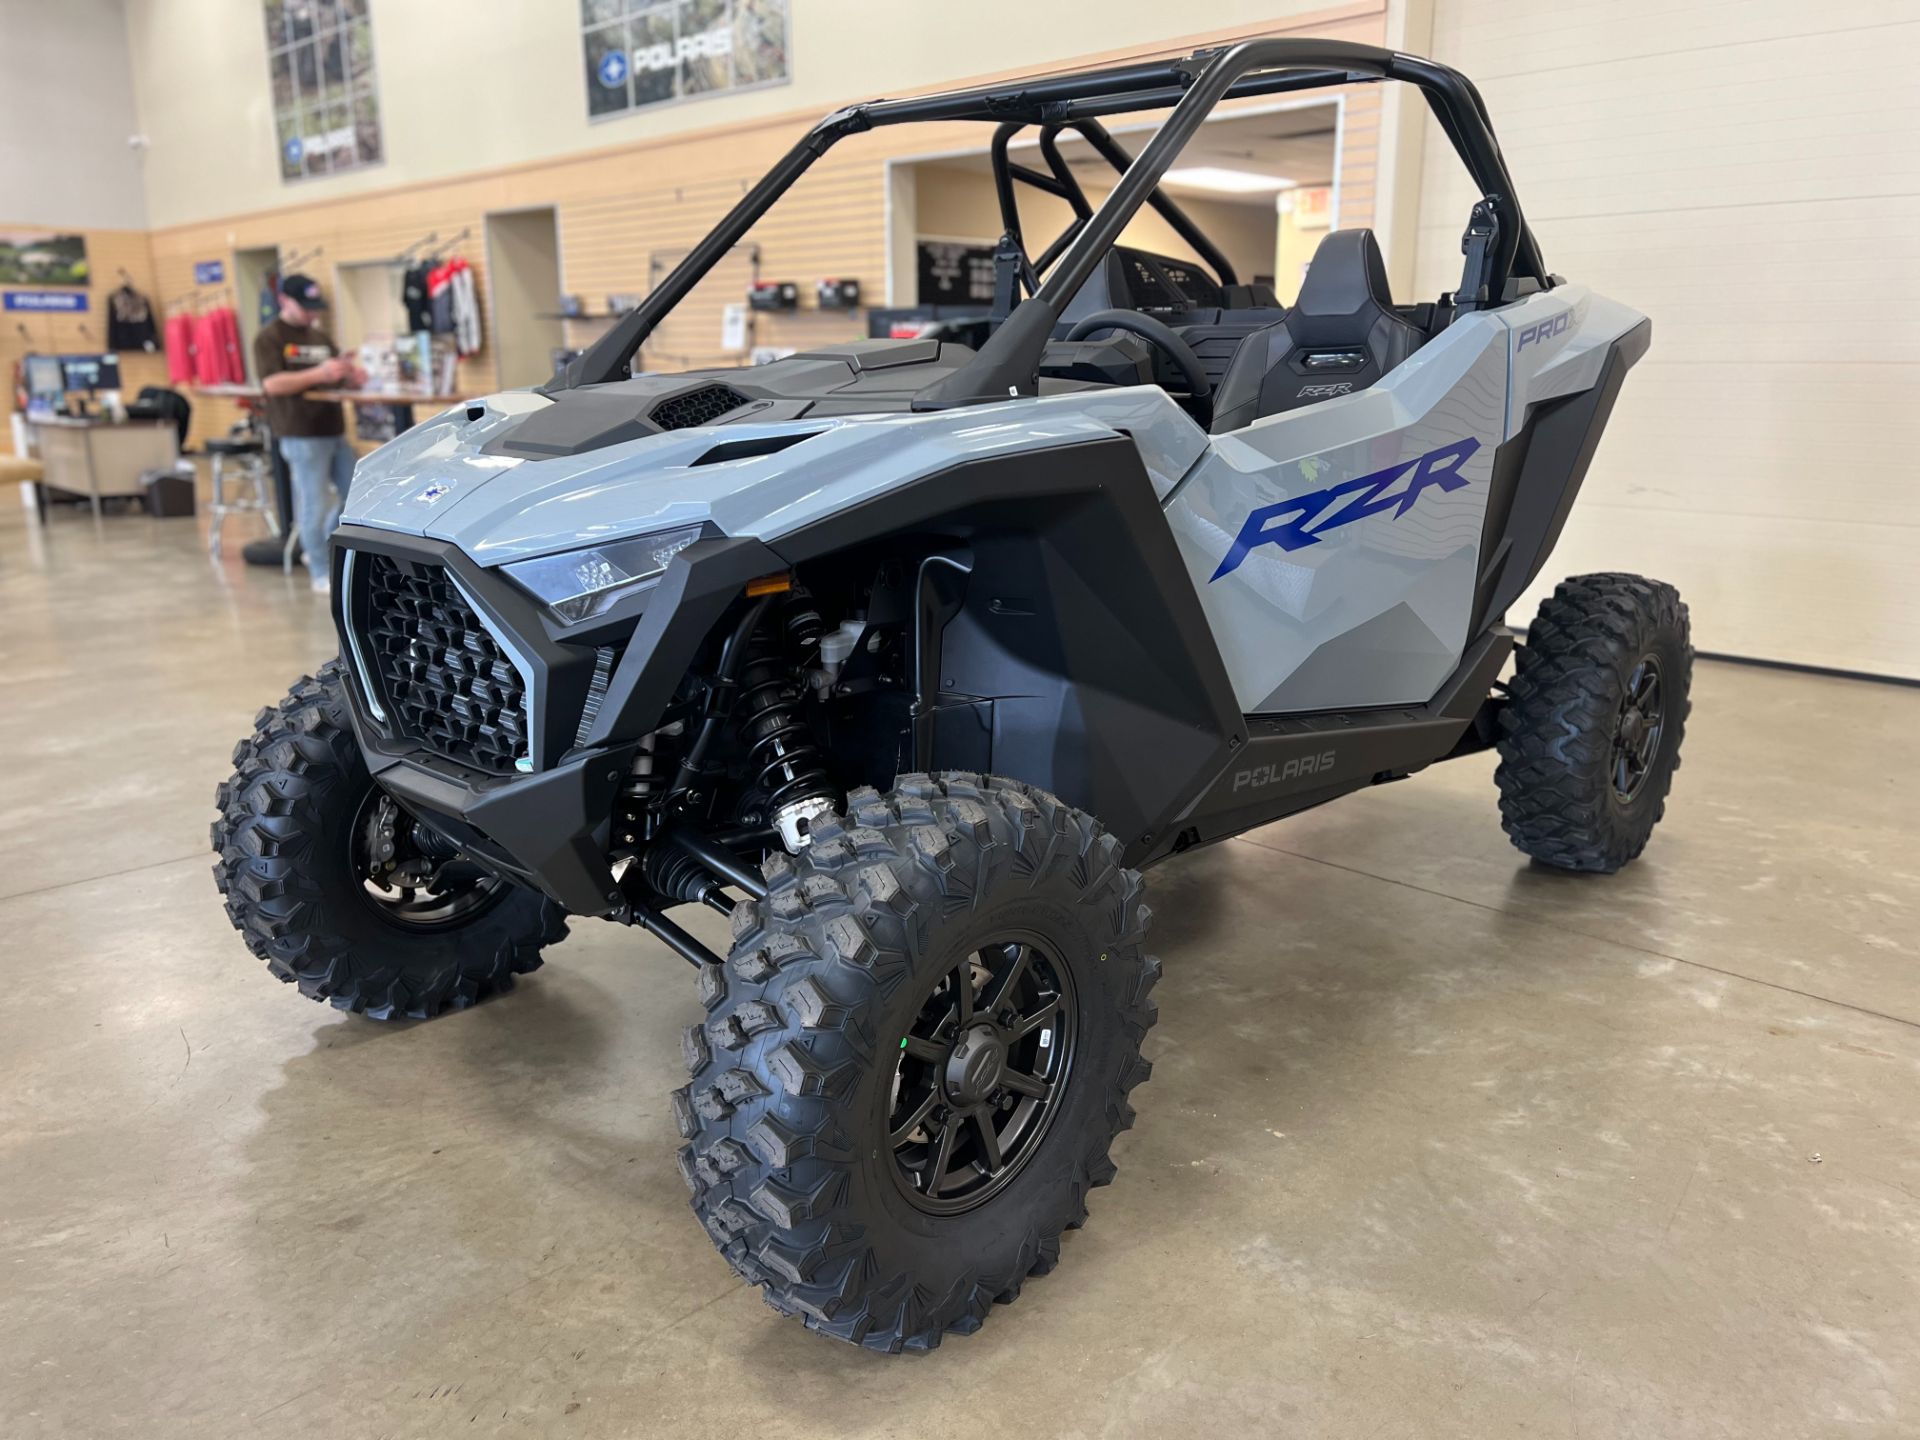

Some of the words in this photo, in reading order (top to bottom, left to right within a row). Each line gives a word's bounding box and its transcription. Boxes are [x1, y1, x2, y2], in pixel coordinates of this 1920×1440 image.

[634, 28, 733, 74] POLARIS
[1296, 382, 1353, 398] RZR
[1207, 436, 1482, 585] RZR
[1232, 749, 1336, 792] POLARIS
